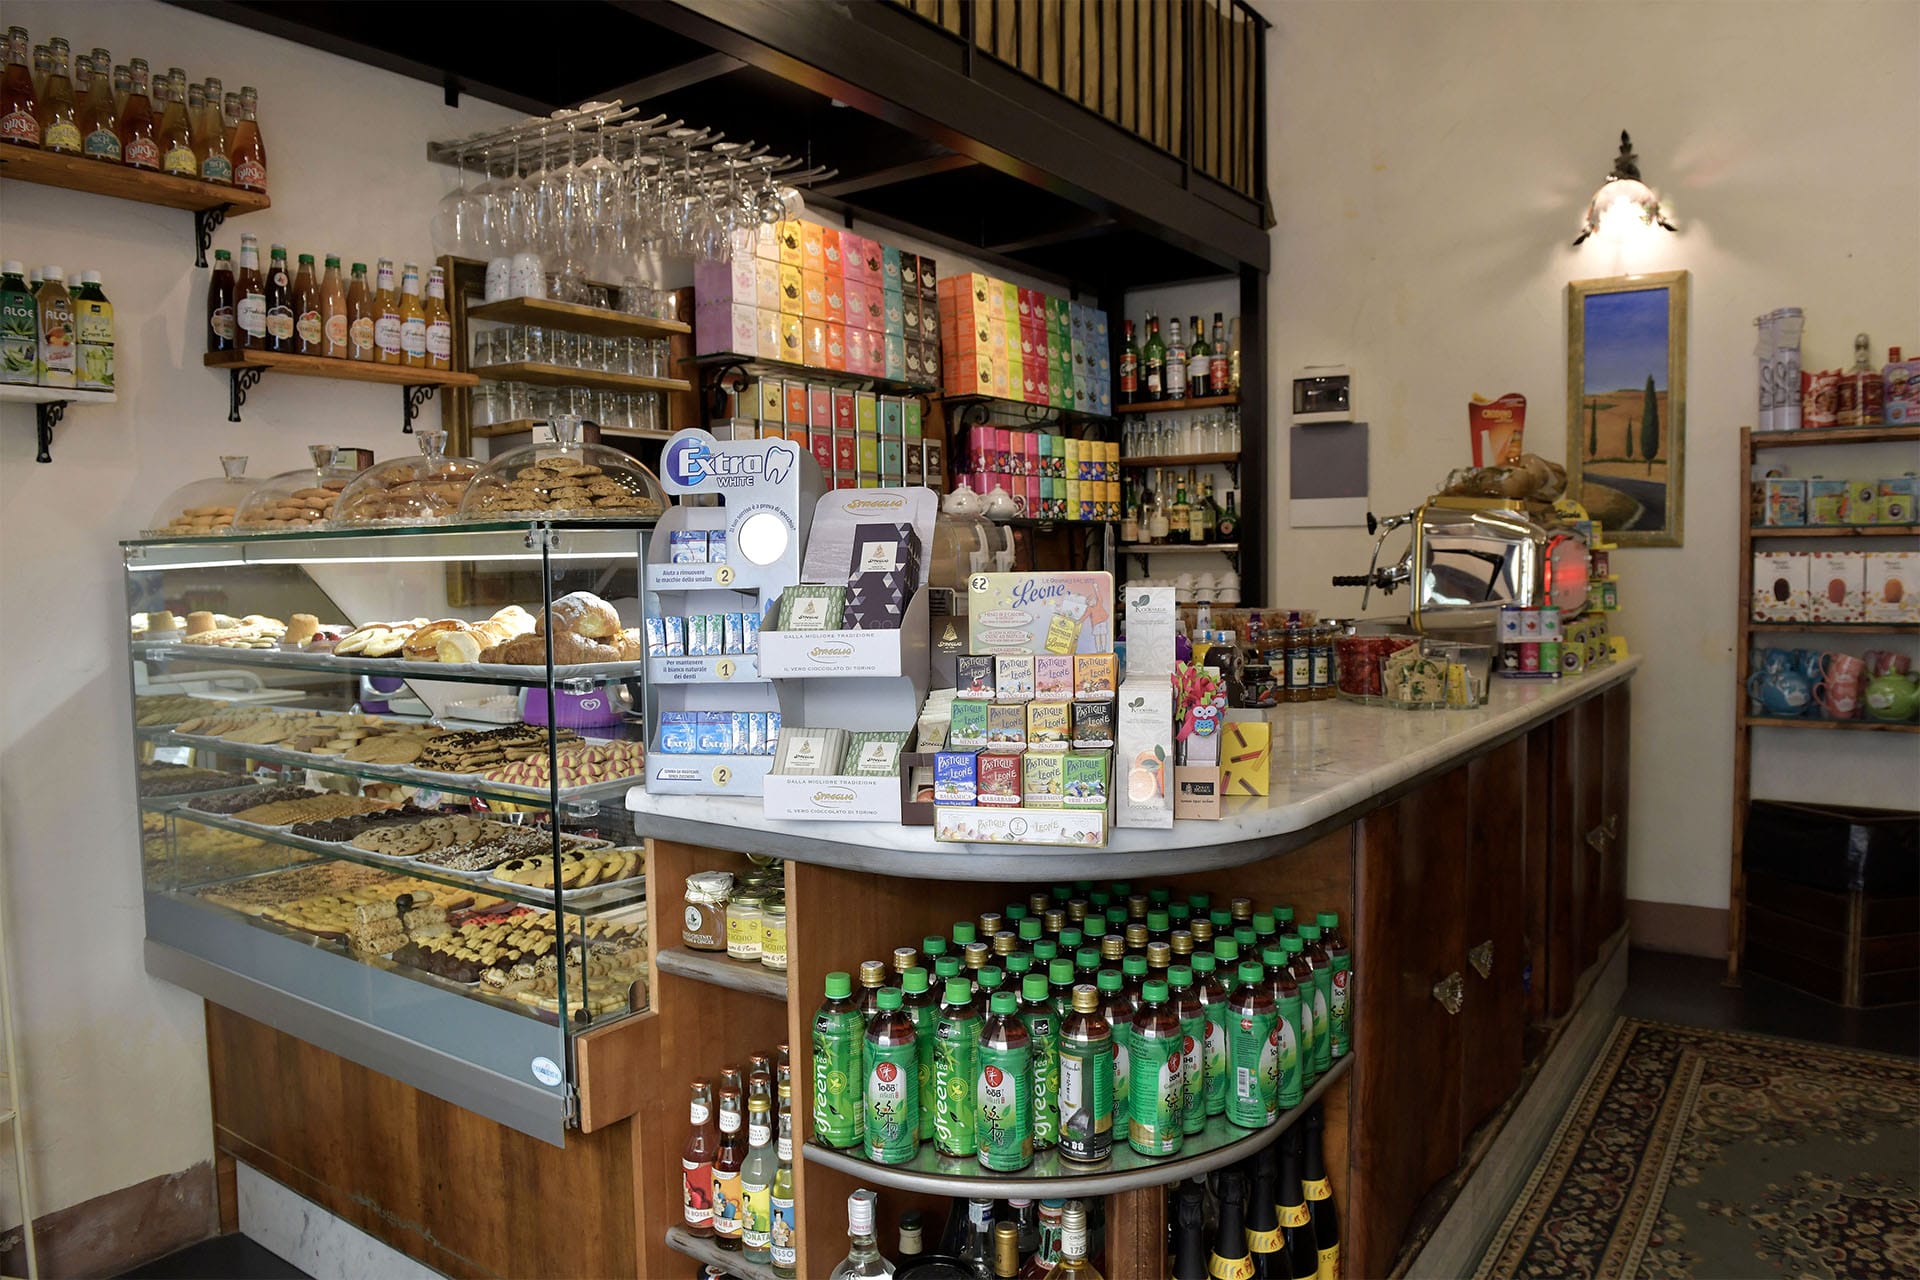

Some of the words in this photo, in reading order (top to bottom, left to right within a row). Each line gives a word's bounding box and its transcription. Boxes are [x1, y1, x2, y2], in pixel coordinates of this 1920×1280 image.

[3, 306, 34, 318] ALOE
[678, 446, 763, 477] Extra
[717, 475, 755, 488] WHITE
[760, 503, 774, 511] prova
[721, 569, 729, 582] 2
[971, 577, 987, 591] €2
[1012, 579, 1065, 609] Leone
[721, 663, 729, 676] 1
[719, 769, 726, 782] 2
[950, 768, 973, 779] LEONE
[994, 770, 1016, 781] LEONE
[936, 1061, 948, 1070] tea
[814, 1064, 832, 1133] green
[934, 1068, 952, 1140] green
[1034, 1064, 1051, 1136] green
